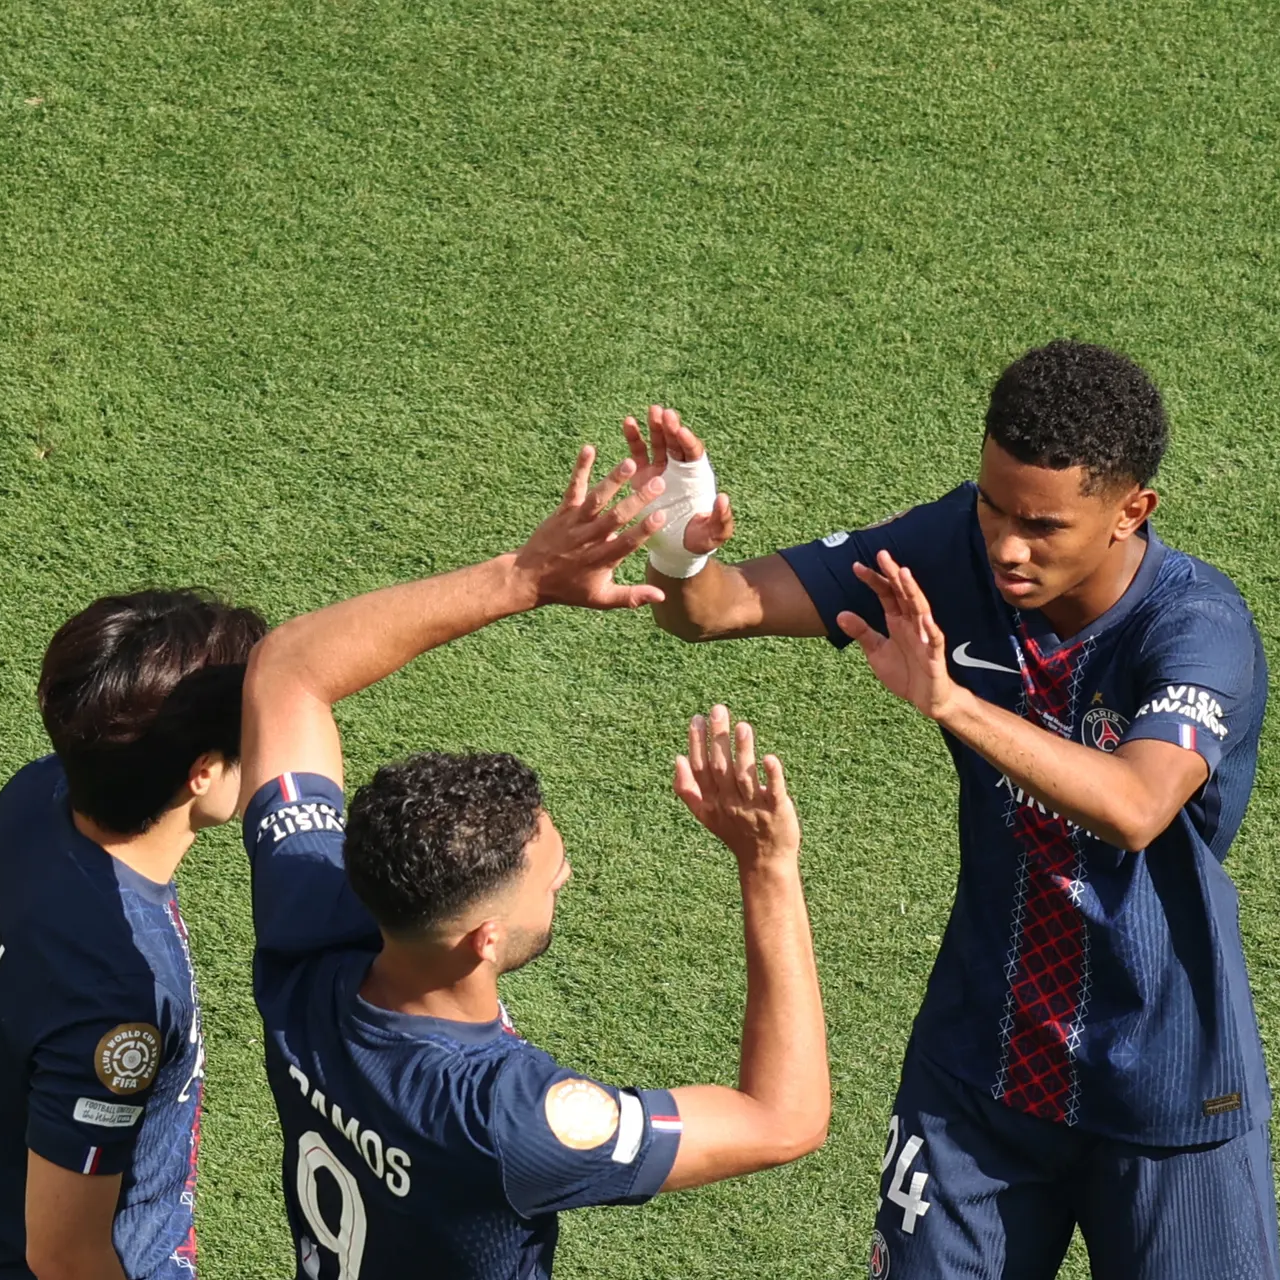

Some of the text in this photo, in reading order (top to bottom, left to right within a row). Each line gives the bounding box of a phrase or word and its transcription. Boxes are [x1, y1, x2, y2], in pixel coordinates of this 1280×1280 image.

[1086, 710, 1120, 724] PARIS
[273, 811, 345, 842] VISIT
[102, 1051, 112, 1074] CLUB
[107, 1030, 140, 1048] WORLD
[142, 1032, 155, 1044] CUP
[112, 1076, 137, 1088] FIFA
[84, 1100, 116, 1114] FOOTBALL
